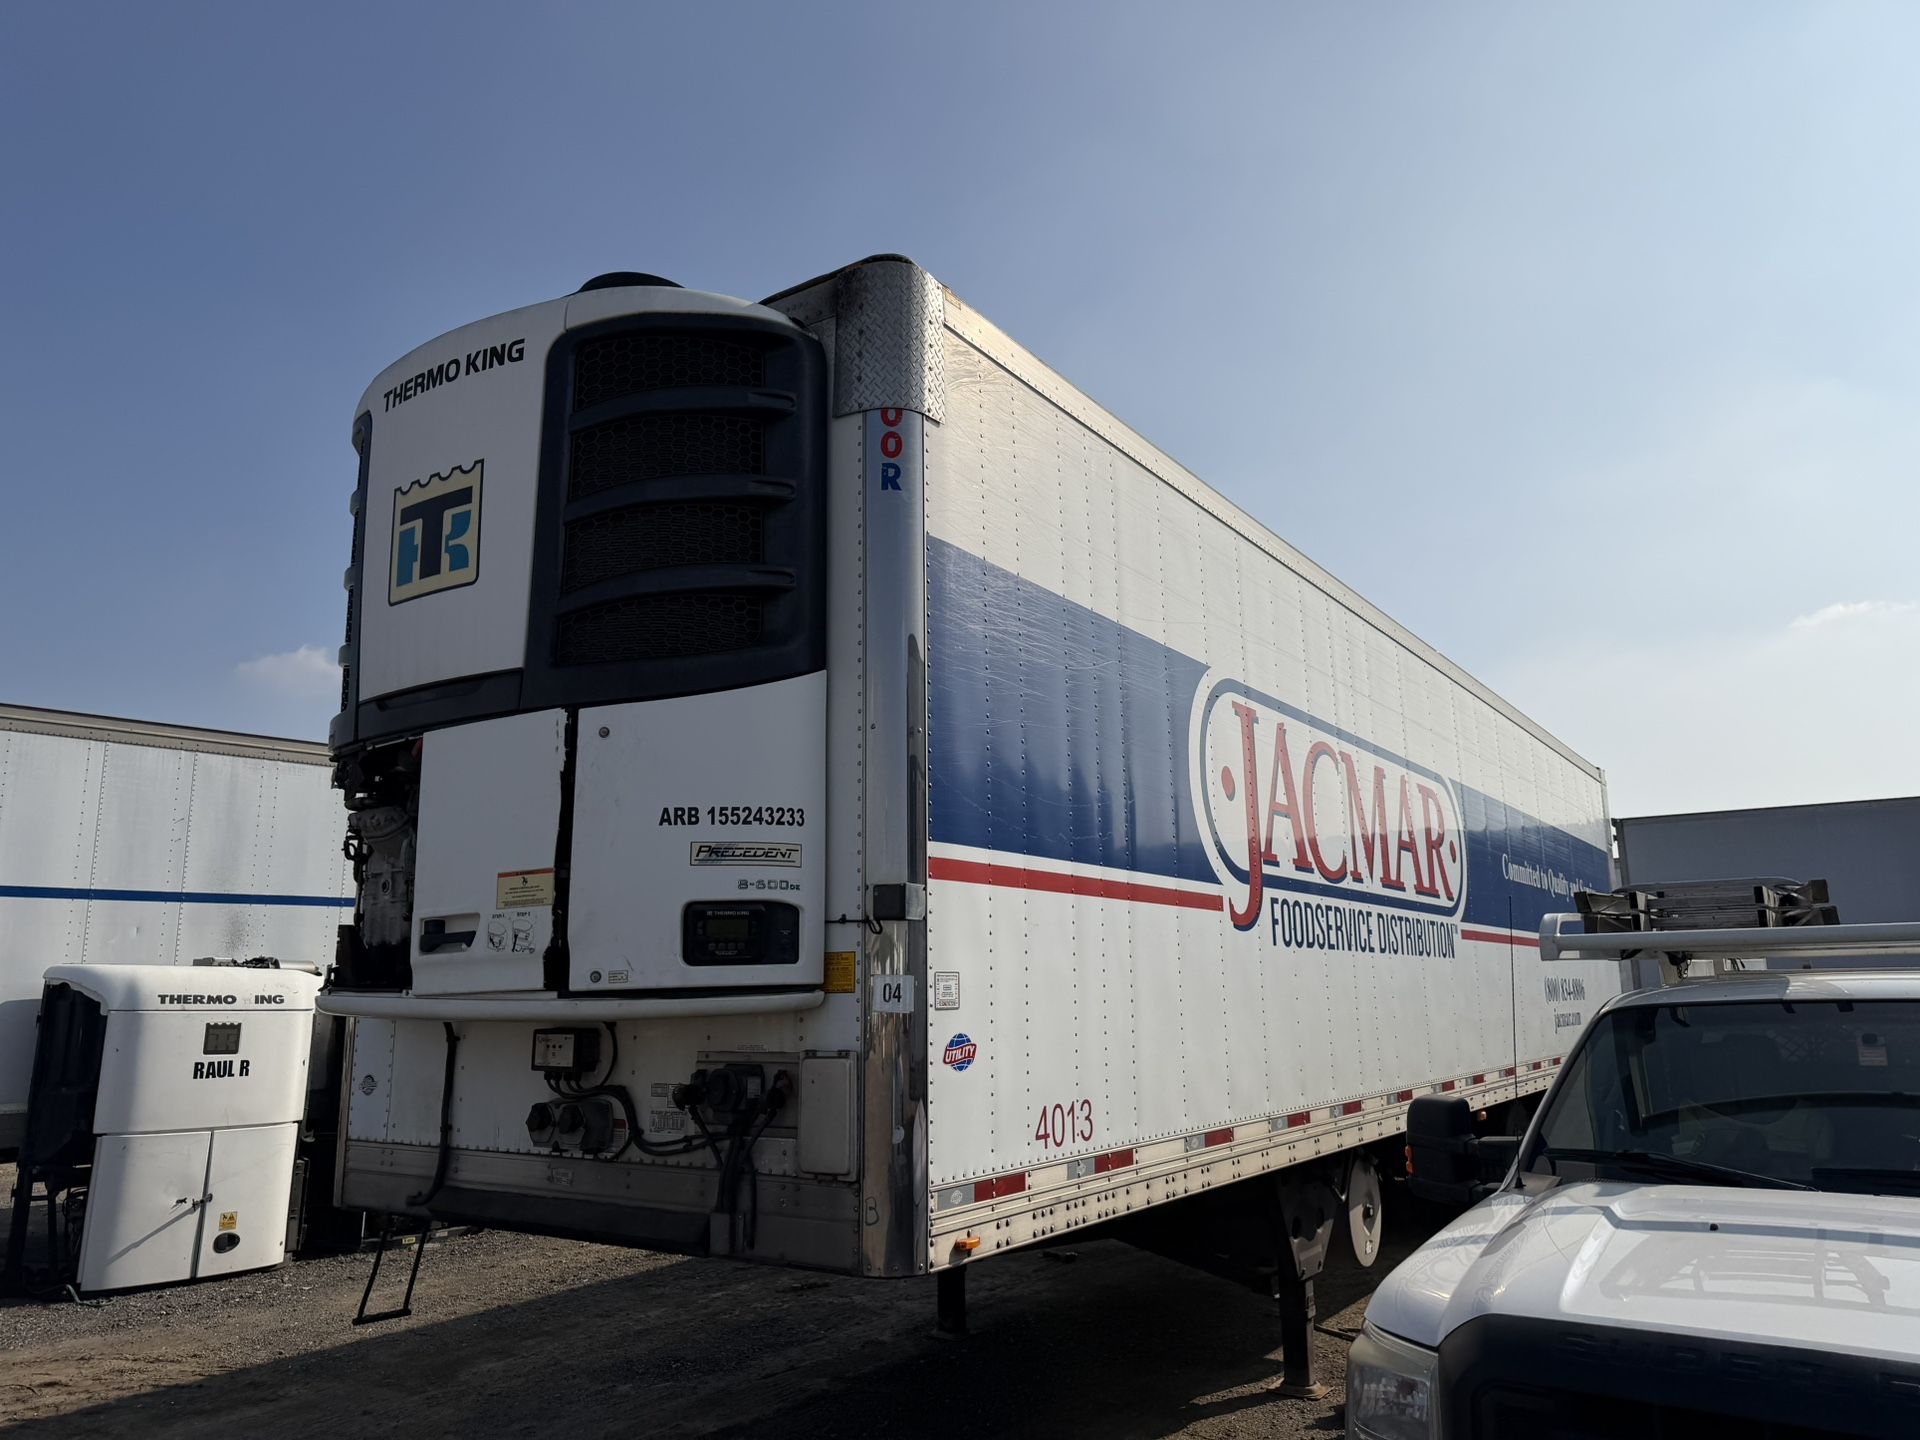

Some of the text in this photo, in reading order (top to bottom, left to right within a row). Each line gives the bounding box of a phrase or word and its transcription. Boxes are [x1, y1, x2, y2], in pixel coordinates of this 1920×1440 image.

[383, 338, 525, 413] THERMO KING
[658, 806, 805, 827] ARB 155243233
[1229, 700, 1455, 931] JACMAR
[695, 845, 799, 859] PRECEDENT
[1502, 853, 1541, 889] Committed
[1541, 868, 1548, 891] to
[1548, 868, 1570, 902] Quality
[1270, 896, 1456, 959] FOODSERVICE DISTRIBUTION
[157, 994, 285, 1005] THERMO ING
[882, 982, 902, 1003] 04
[944, 1045, 976, 1063] UTILITY
[192, 1059, 250, 1080] RAUL R
[1035, 1098, 1093, 1149] 4013
